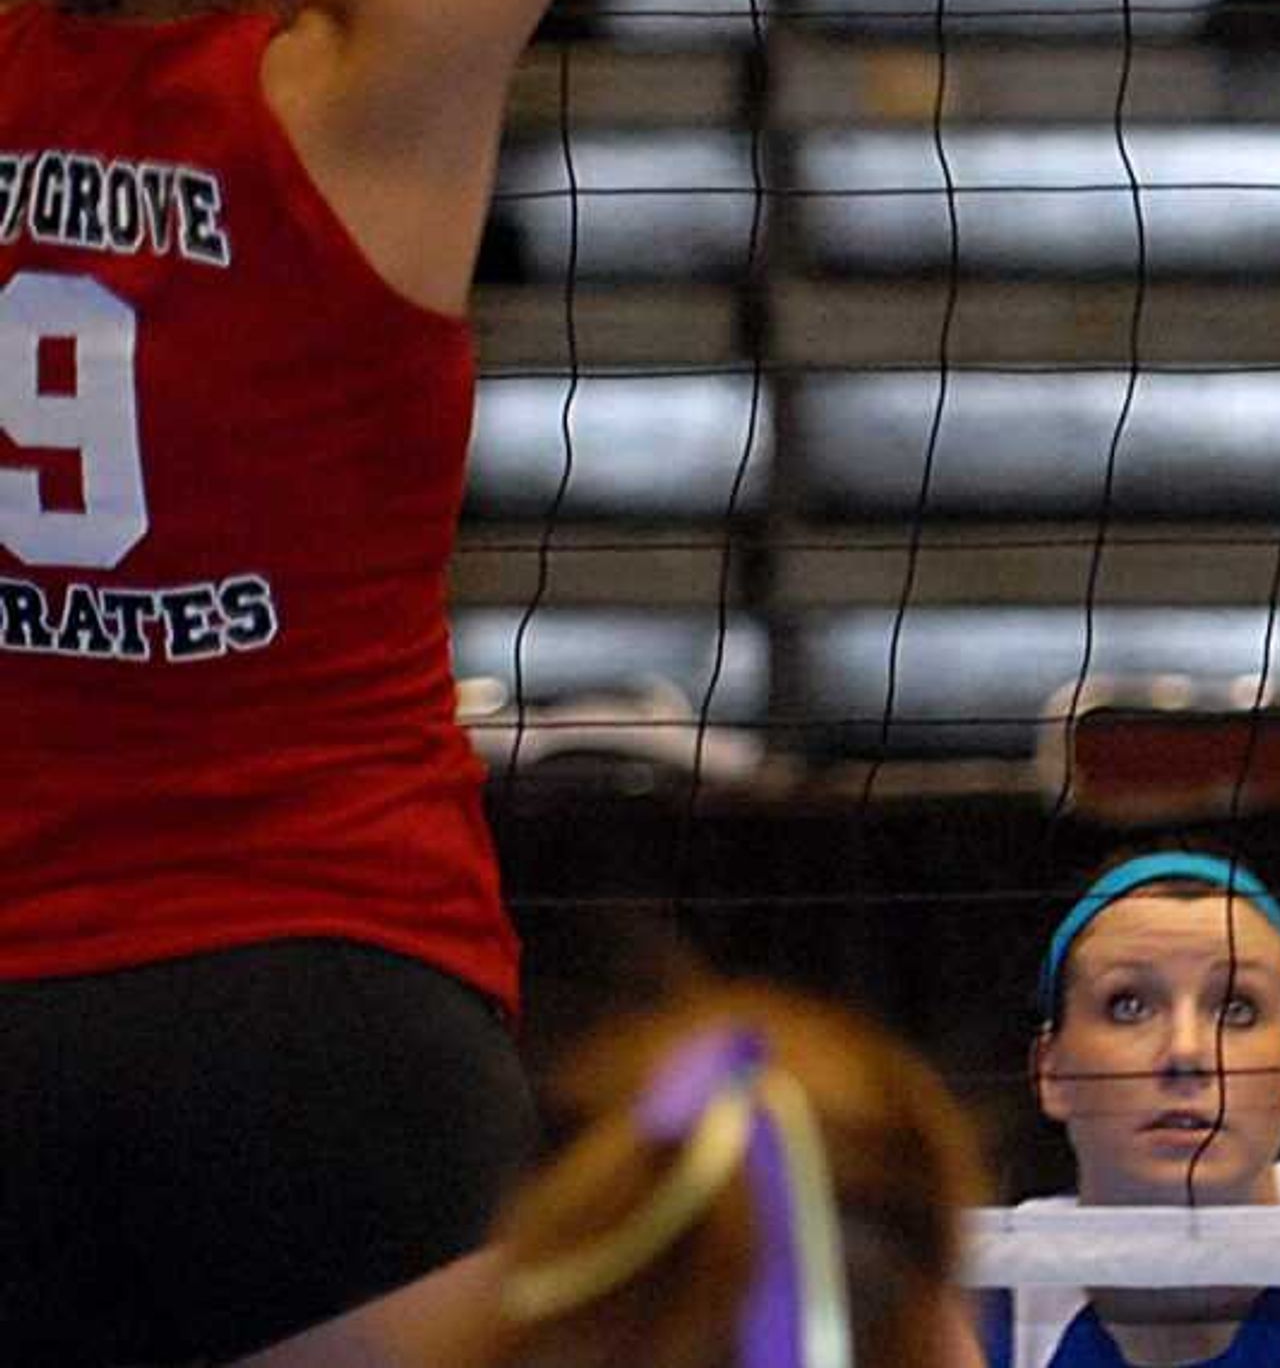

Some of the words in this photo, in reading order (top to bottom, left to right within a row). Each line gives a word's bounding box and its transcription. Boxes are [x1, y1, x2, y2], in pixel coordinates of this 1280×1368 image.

[30, 149, 231, 267] GROVE
[0, 269, 149, 571] 9
[0, 574, 278, 663] RATES
